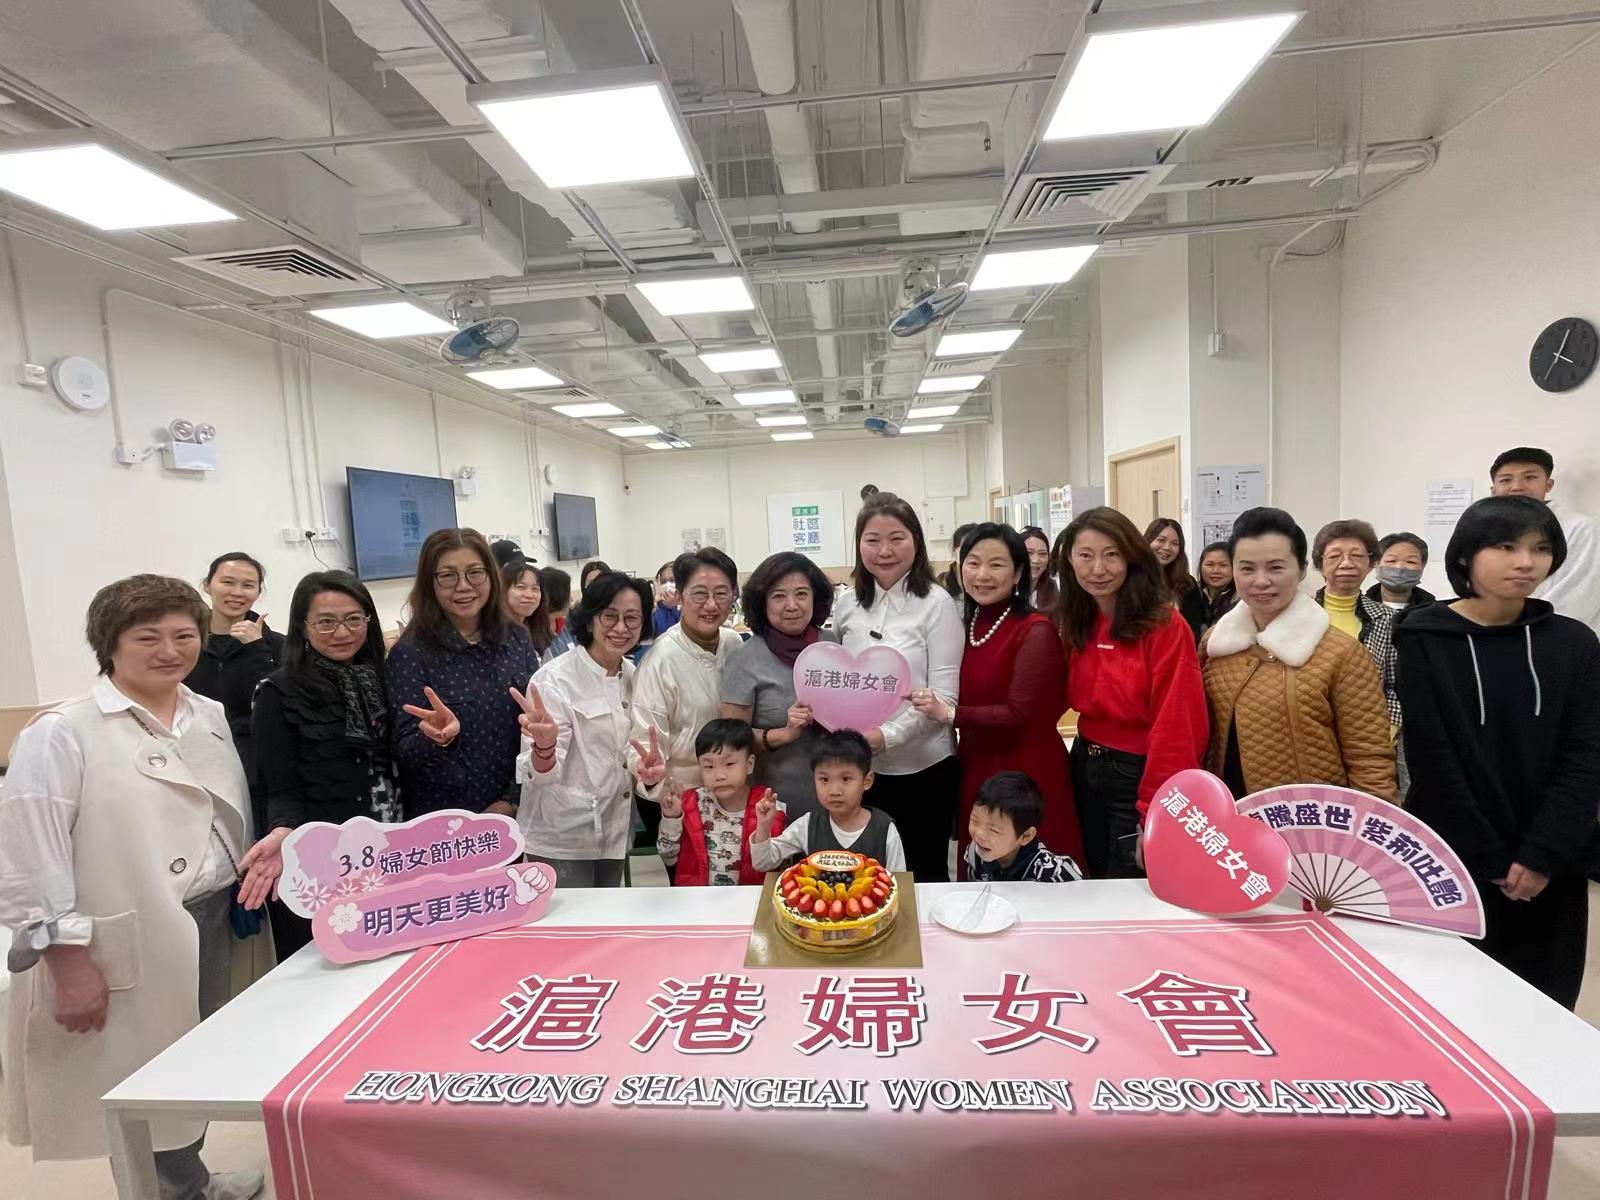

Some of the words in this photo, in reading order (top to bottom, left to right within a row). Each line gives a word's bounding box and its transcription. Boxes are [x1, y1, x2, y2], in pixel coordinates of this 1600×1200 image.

[804, 668, 899, 693] 滬港婦女會
[1160, 786, 1272, 902] 滬港婦女會
[364, 884, 511, 937] 明天更美好
[470, 970, 1275, 1057] 滬港婦女會
[344, 1070, 608, 1105] HONGKONG
[612, 1074, 868, 1109] SHANGHAI
[879, 1078, 1074, 1112] WOMEN
[1089, 1077, 1447, 1117] ASSOCIATION
